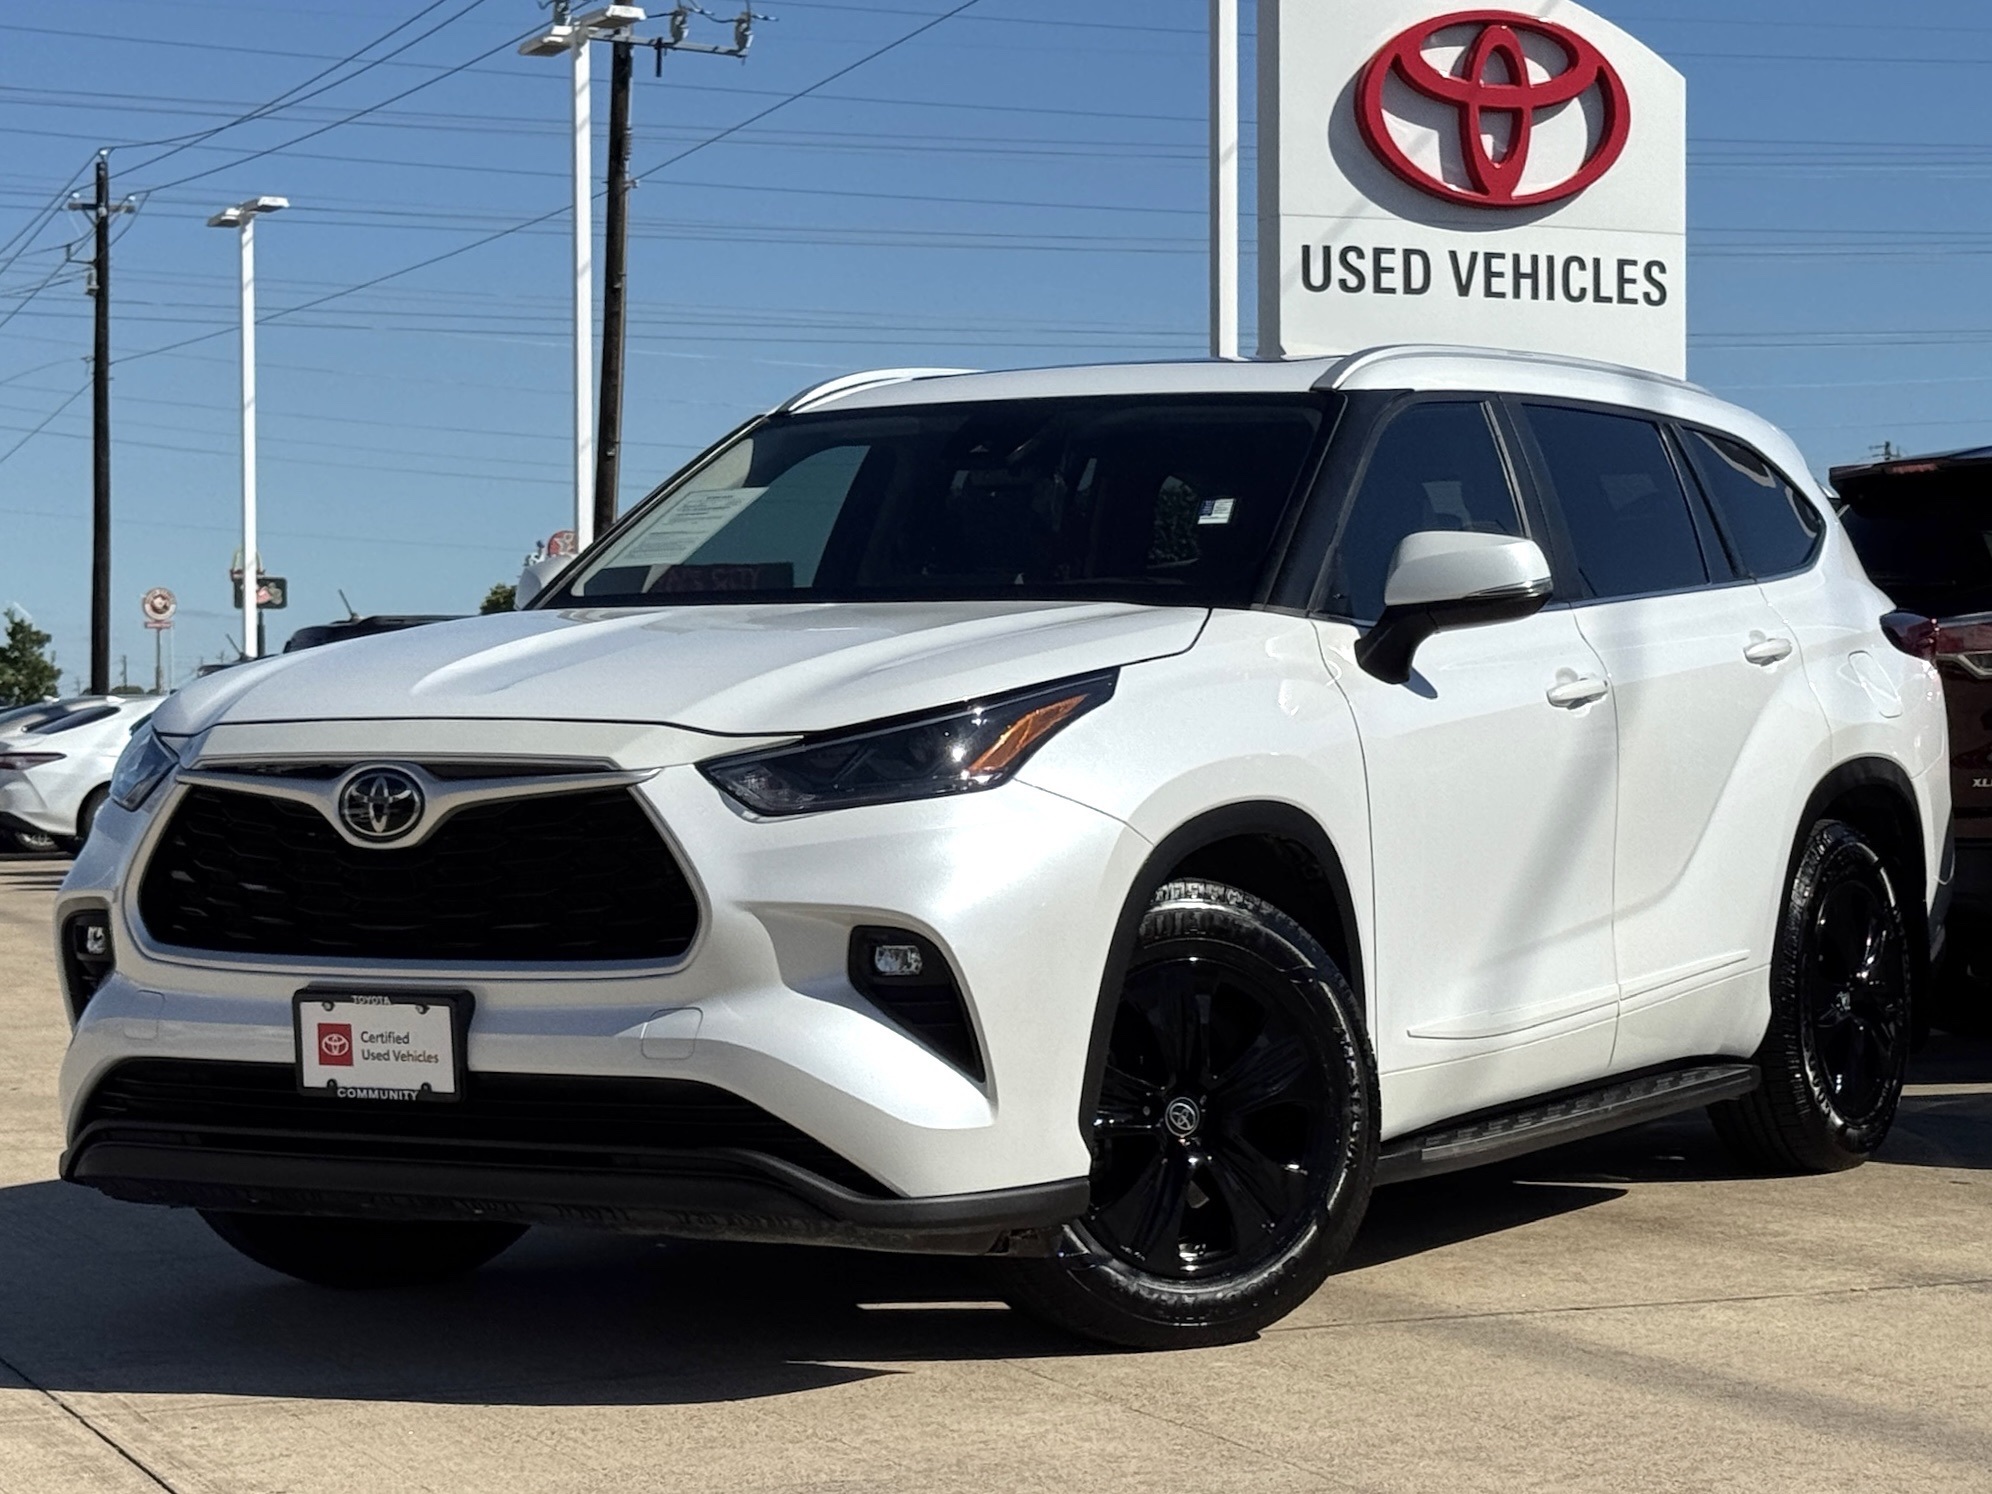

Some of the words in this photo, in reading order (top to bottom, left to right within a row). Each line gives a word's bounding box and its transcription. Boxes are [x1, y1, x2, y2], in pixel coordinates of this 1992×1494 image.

[1301, 244, 1431, 295] USED
[1448, 250, 1667, 306] VEHICLES
[1972, 778, 1992, 787] XL
[351, 995, 392, 1005] TOYOTA
[360, 1031, 410, 1045] Certified
[361, 1049, 390, 1061] Used
[393, 1051, 439, 1064] Vehicles
[337, 1088, 420, 1100] COMMUNITY
